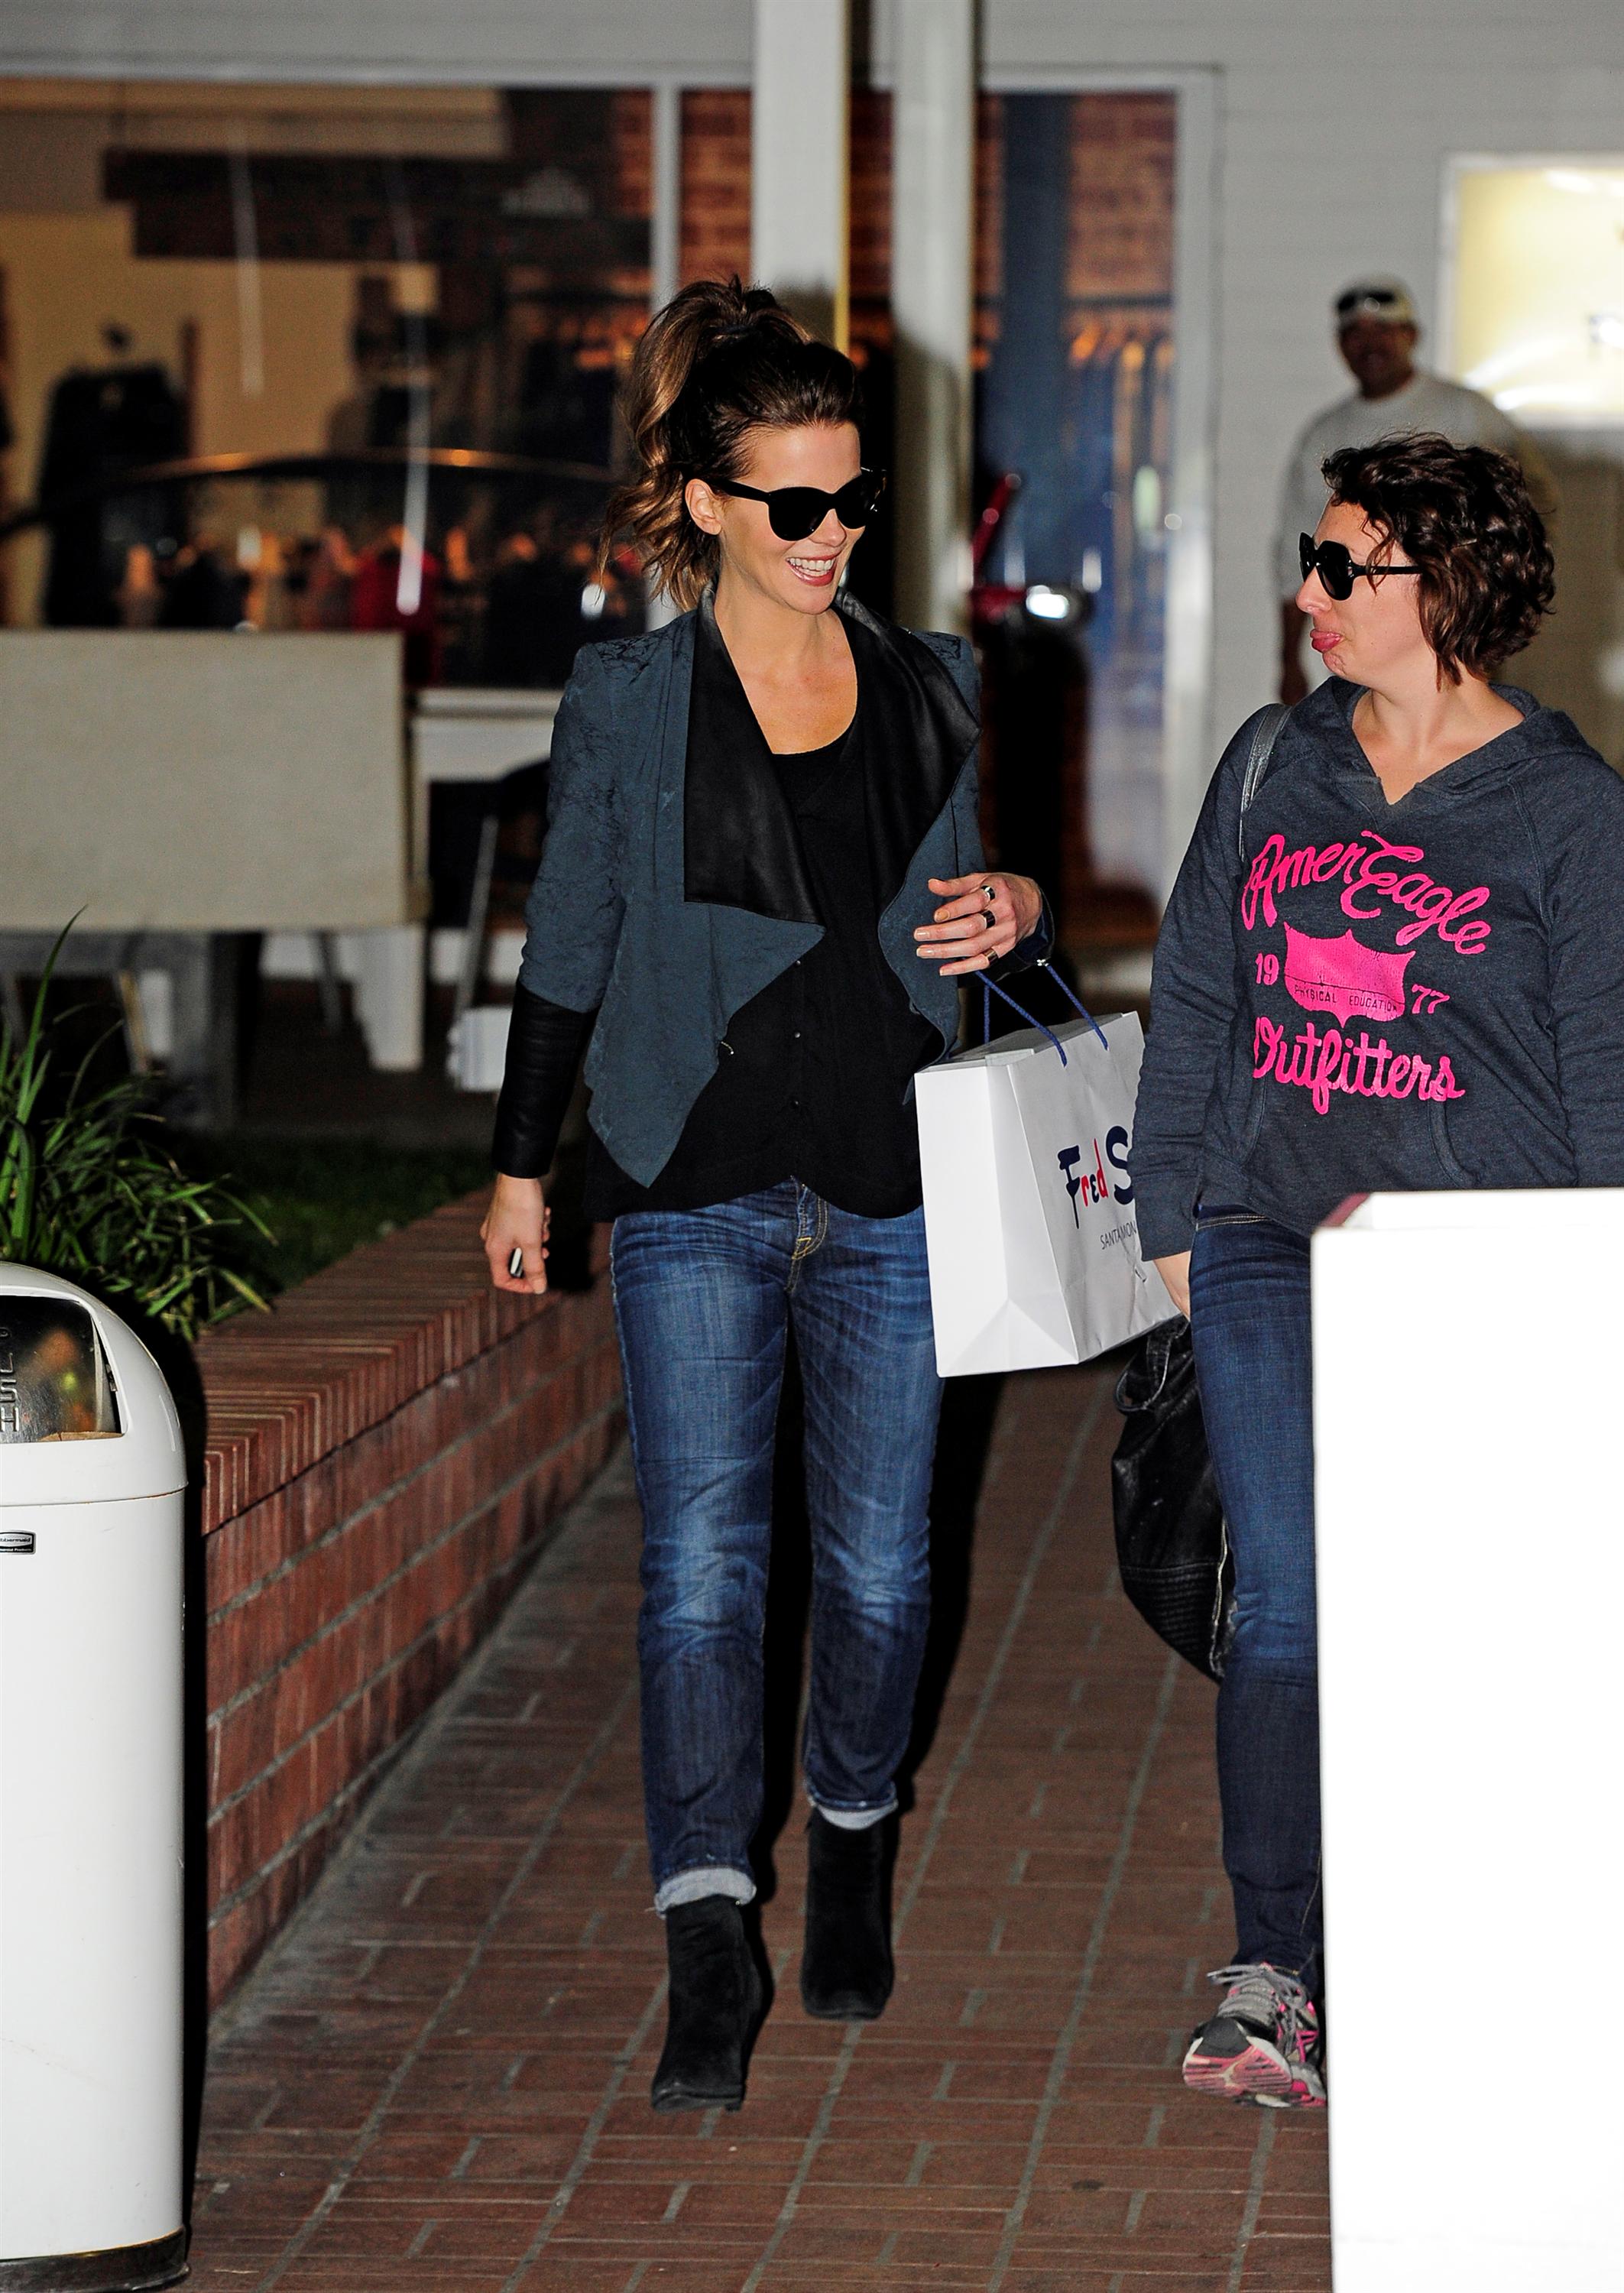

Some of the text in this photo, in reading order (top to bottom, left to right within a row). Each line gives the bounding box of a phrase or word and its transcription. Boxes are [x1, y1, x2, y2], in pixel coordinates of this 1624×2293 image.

[1241, 830, 1492, 955] Amer Eagle
[1256, 952, 1451, 1014] 19 77
[1294, 984, 1398, 1013] PHYSICAL EDUCATION
[1253, 1016, 1466, 1115] Outfitters
[1057, 1137, 1109, 1229] Fred
